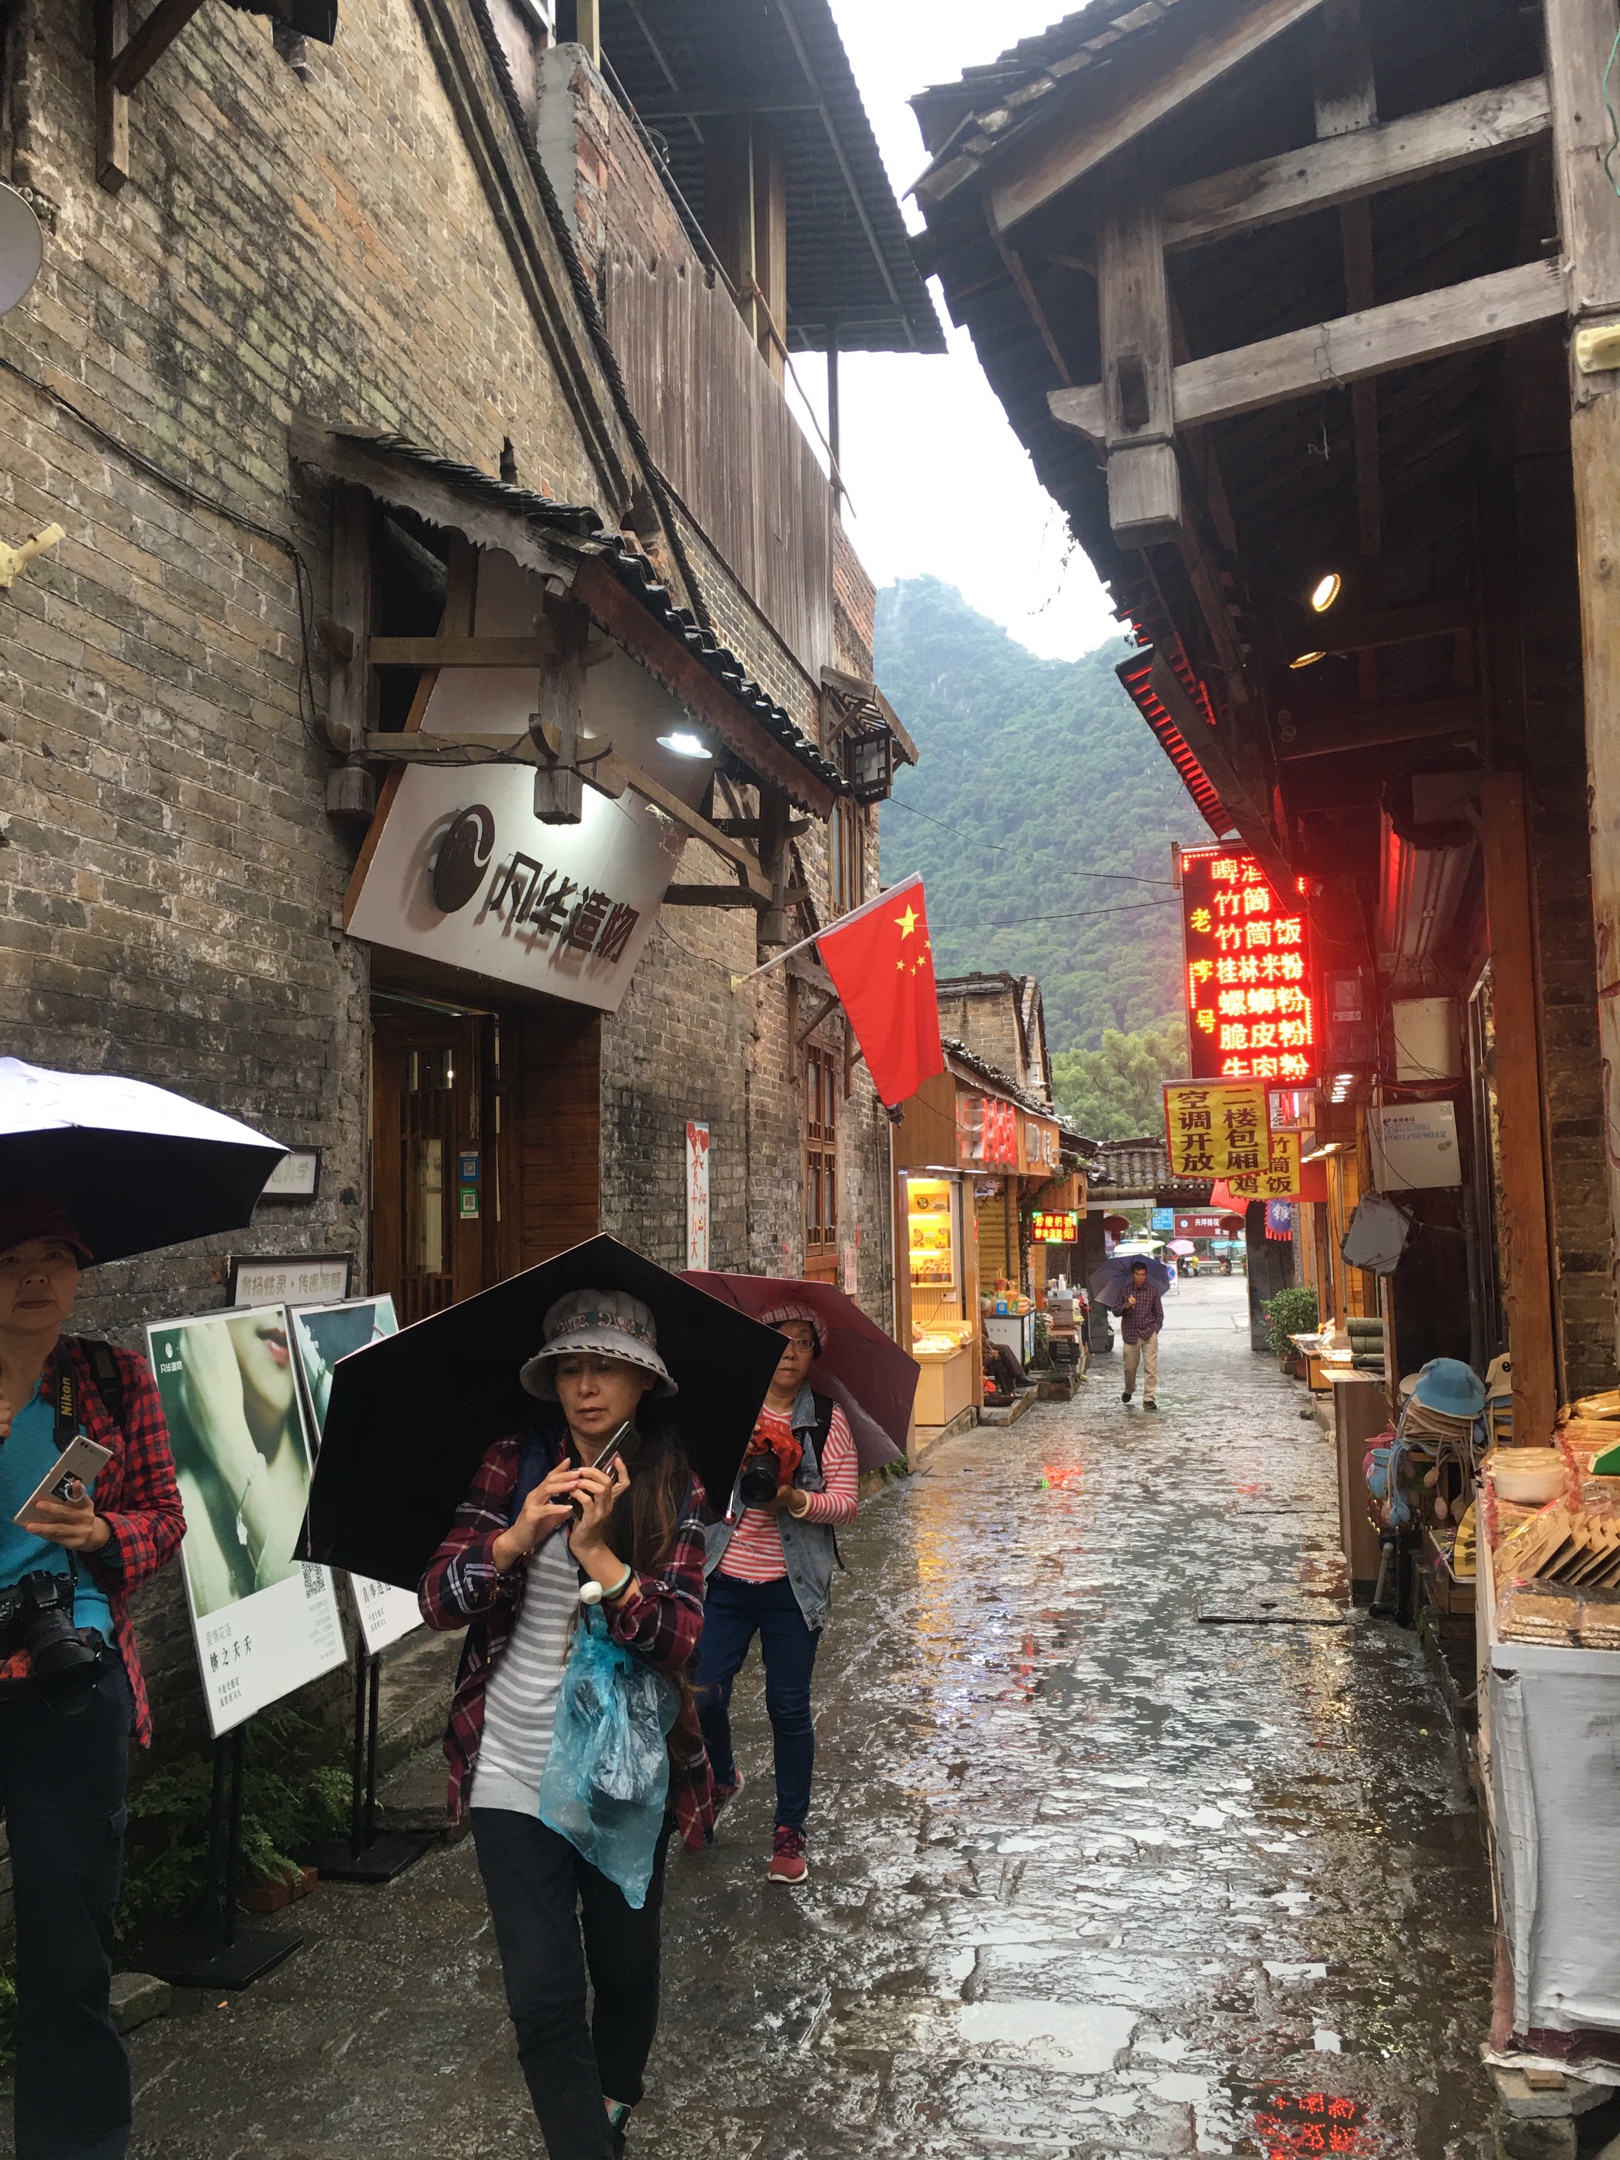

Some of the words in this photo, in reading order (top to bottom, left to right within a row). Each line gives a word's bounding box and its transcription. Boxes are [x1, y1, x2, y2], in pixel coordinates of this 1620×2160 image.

[1214, 917, 1303, 951] 竹筒饭
[1190, 907, 1216, 1034] 老字号
[1216, 952, 1304, 985] 桂林米粉
[1220, 1019, 1308, 1051] 脆皮粉
[1221, 1052, 1310, 1081] 牛肉粉
[1176, 1089, 1216, 1173] 空调开放
[1222, 1087, 1260, 1171] 二楼包厢
[1266, 1136, 1293, 1194] 竹筒饭
[61, 1376, 72, 1417] Nikon
